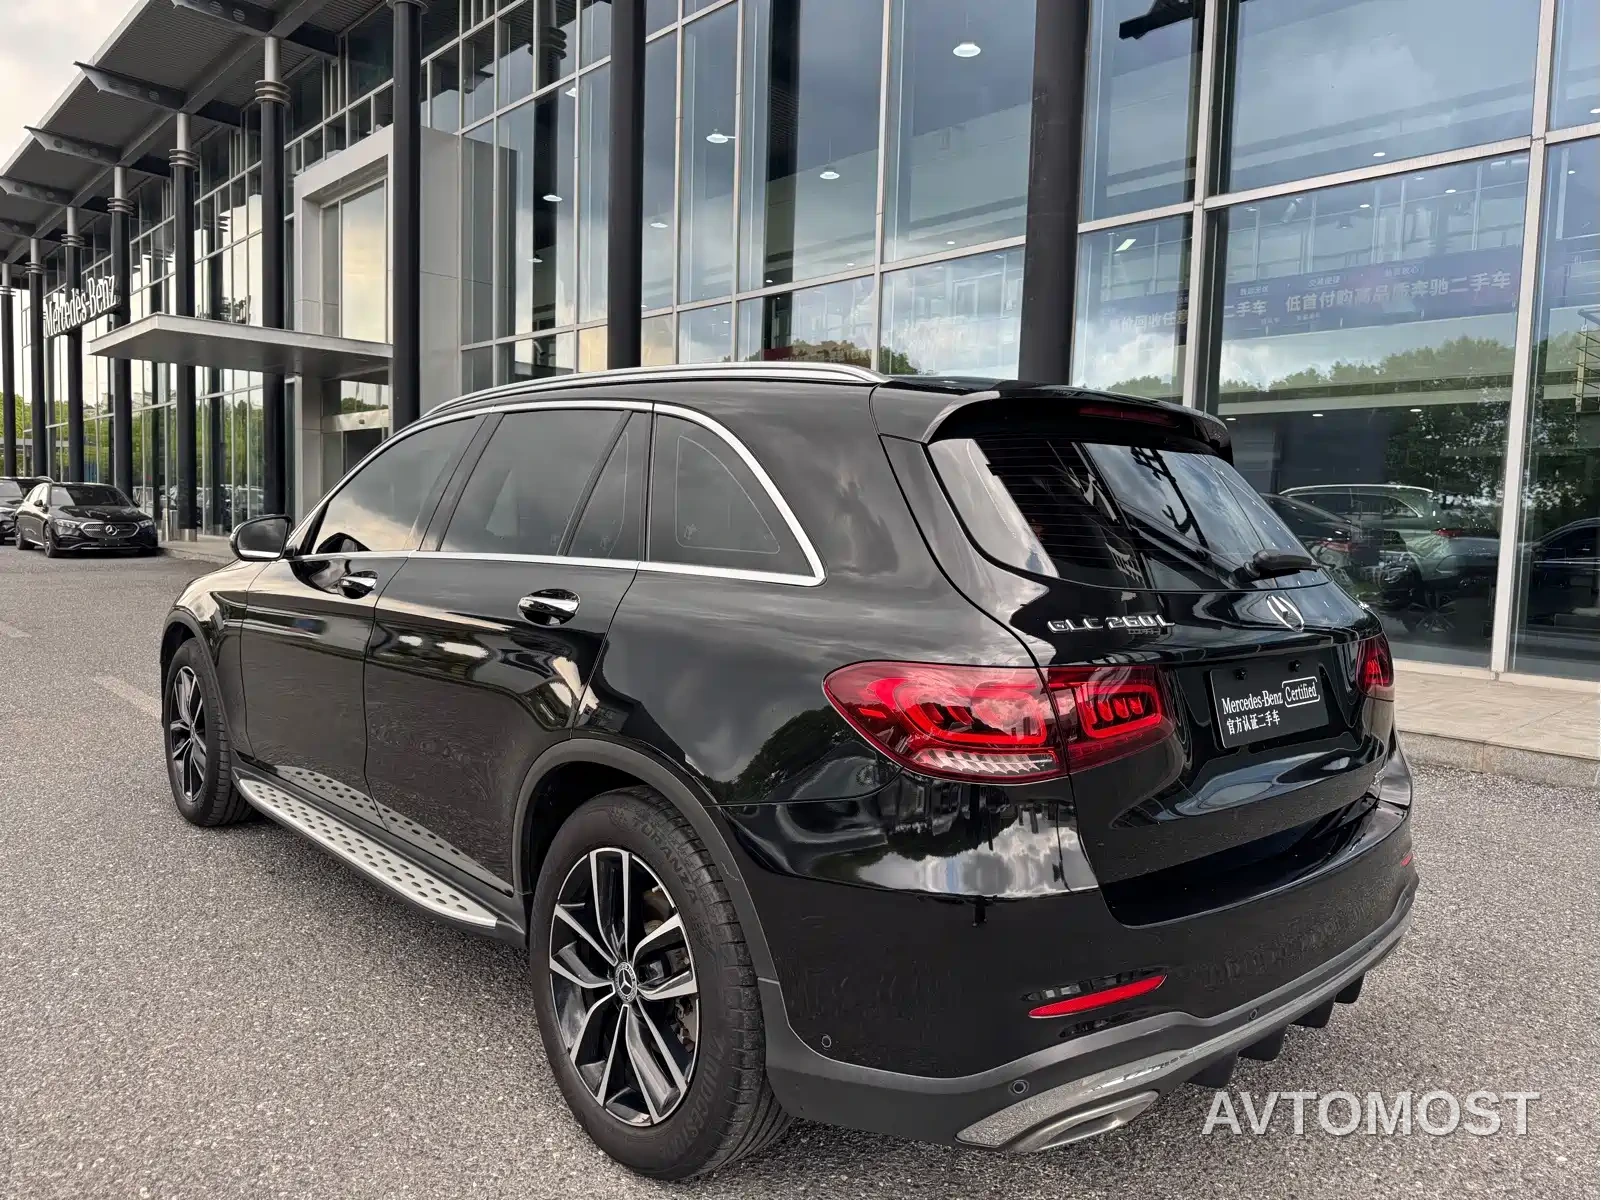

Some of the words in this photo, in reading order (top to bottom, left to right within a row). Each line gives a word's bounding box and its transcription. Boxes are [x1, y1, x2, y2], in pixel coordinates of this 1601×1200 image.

[43, 275, 115, 339] Mercedes-Benz
[1047, 617, 1104, 634] GLC
[1221, 690, 1284, 715] Mercedes-Benz
[1285, 681, 1318, 702] Certified
[1226, 709, 1281, 735] 官方认证二手车
[632, 816, 698, 904] TURANZA
